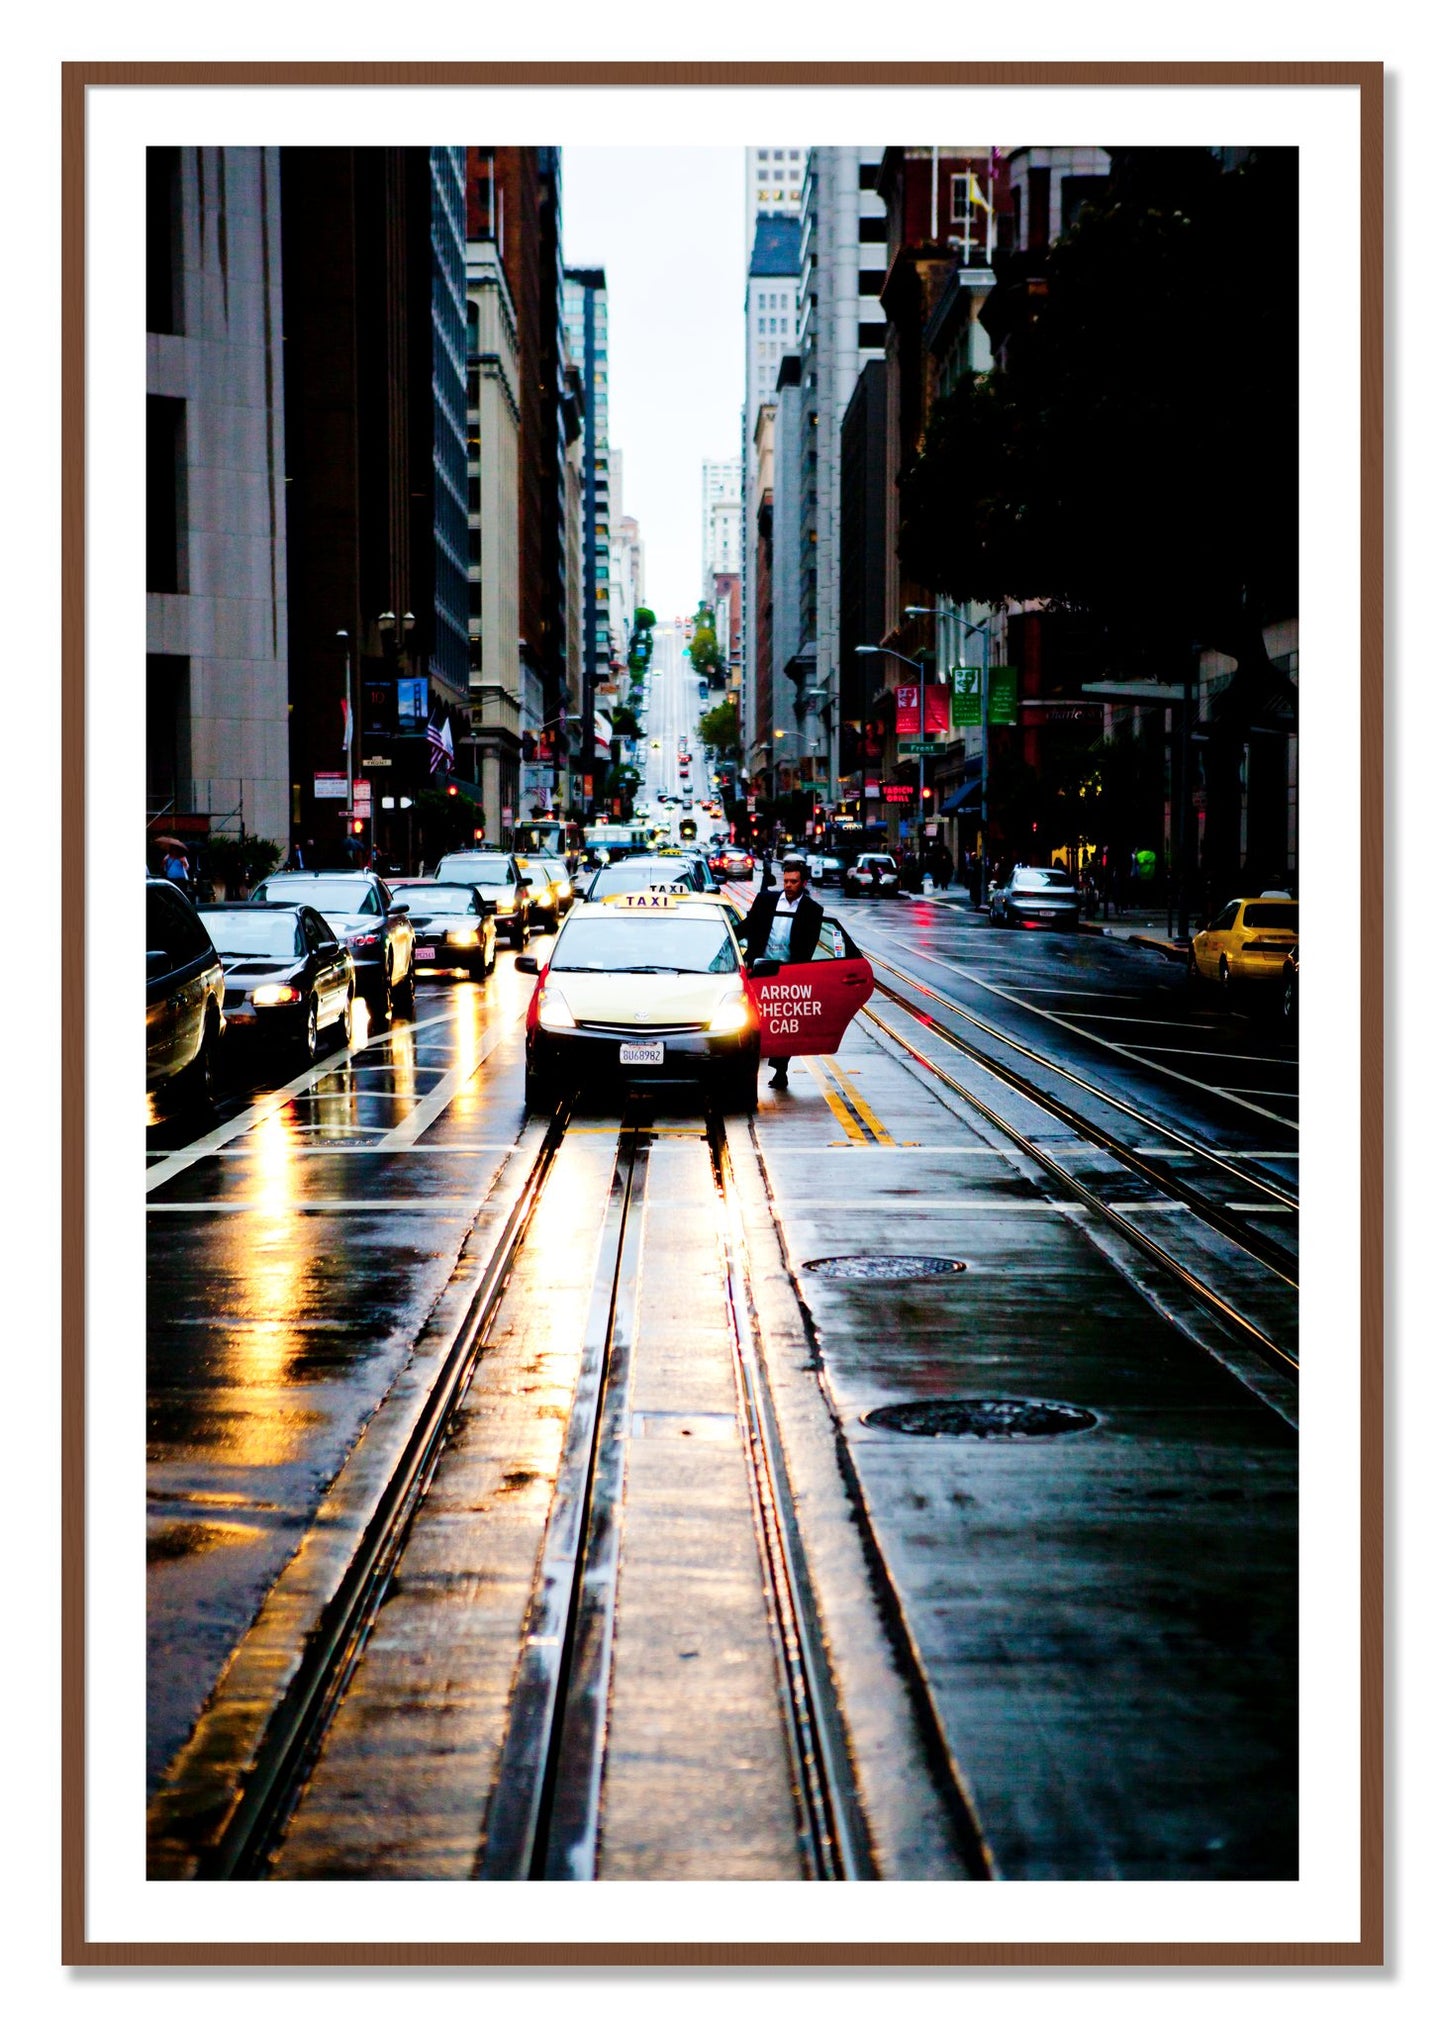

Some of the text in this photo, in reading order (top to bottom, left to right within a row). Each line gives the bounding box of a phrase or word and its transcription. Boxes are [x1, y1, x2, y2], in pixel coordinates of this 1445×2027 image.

[910, 744, 935, 752] Front
[882, 786, 914, 795] TADICH
[886, 795, 910, 803] GRILL
[650, 885, 684, 894] TAXI
[626, 896, 668, 907] TAXI
[760, 984, 812, 1000] ARROW
[769, 1019, 799, 1034] CAB
